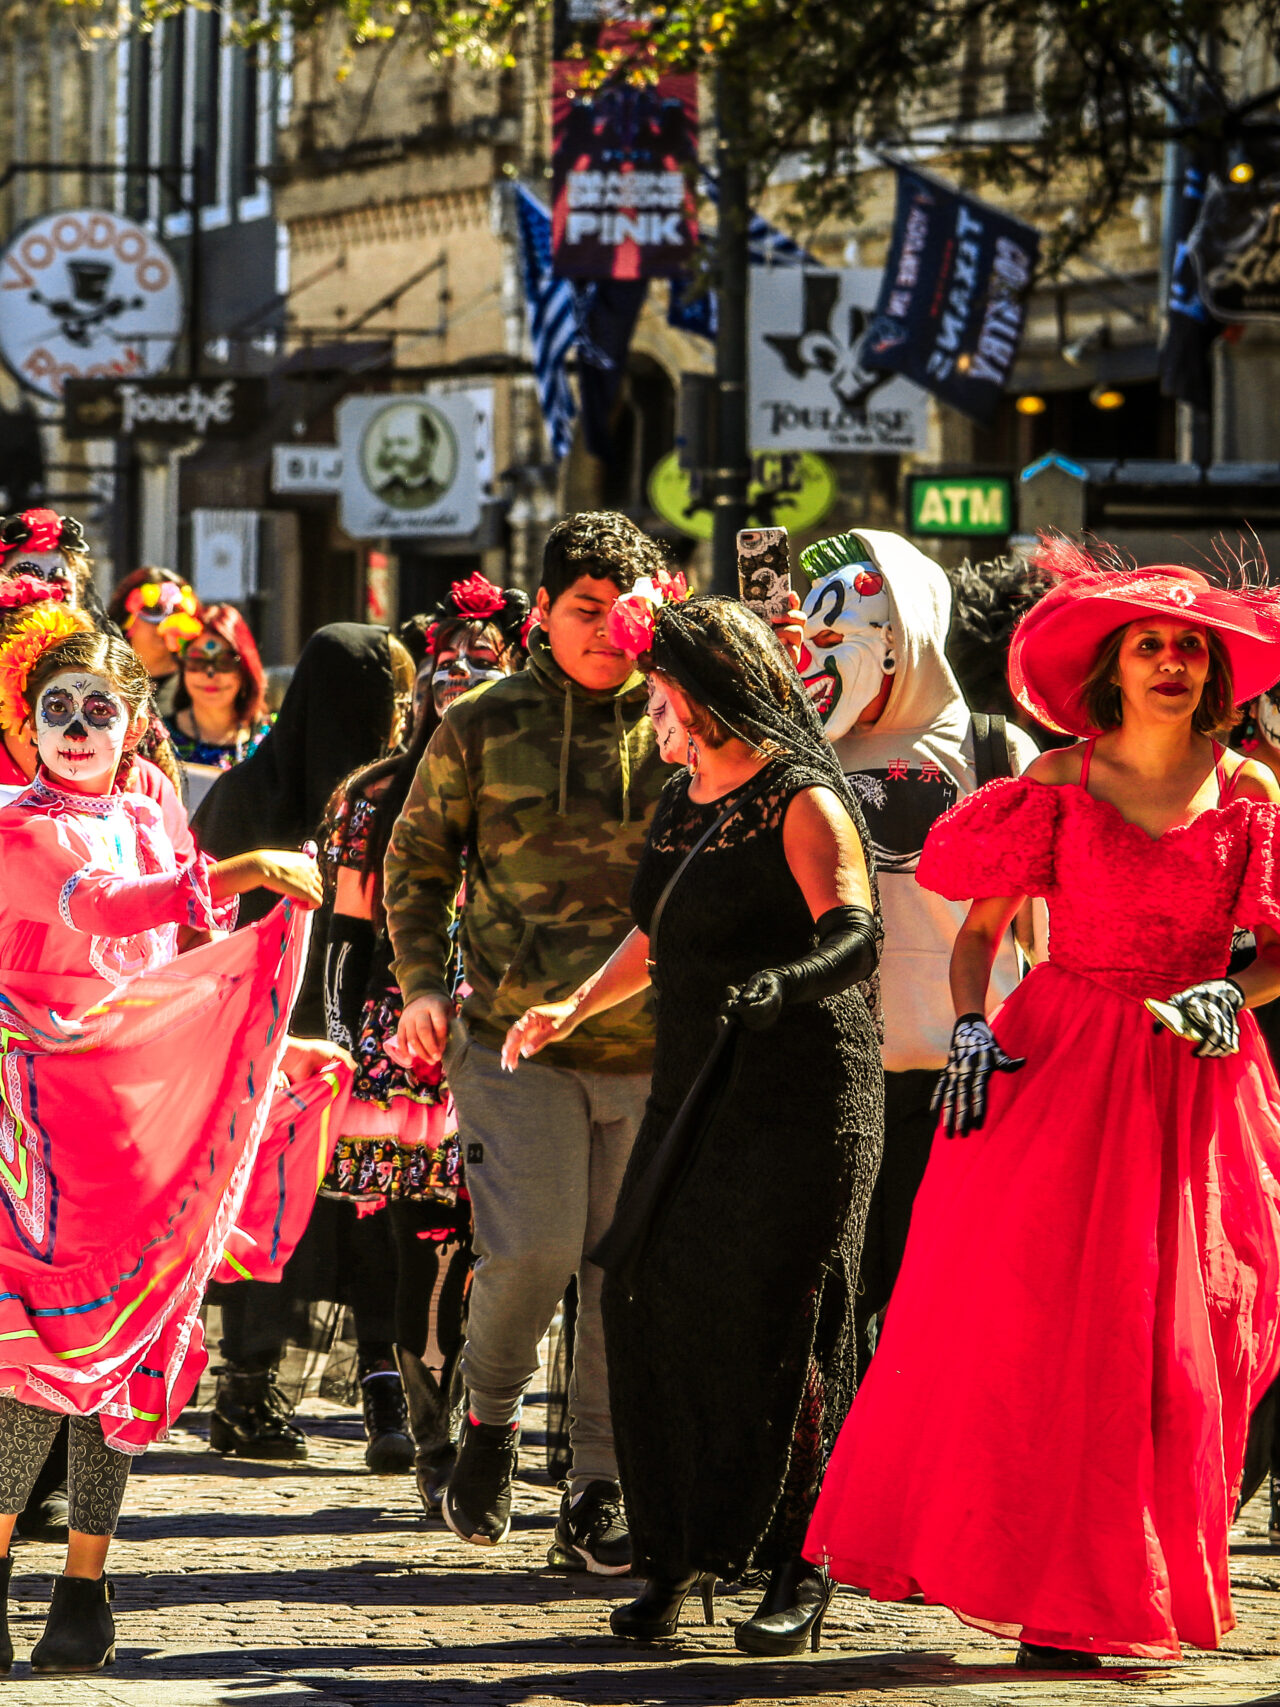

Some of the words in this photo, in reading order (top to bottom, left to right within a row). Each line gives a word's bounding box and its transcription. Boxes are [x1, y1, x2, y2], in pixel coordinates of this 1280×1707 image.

[0, 214, 170, 293] VOODOO
[761, 401, 912, 436] TOULOUSE
[918, 486, 1004, 526] ATM
[884, 757, 942, 784] 東京
